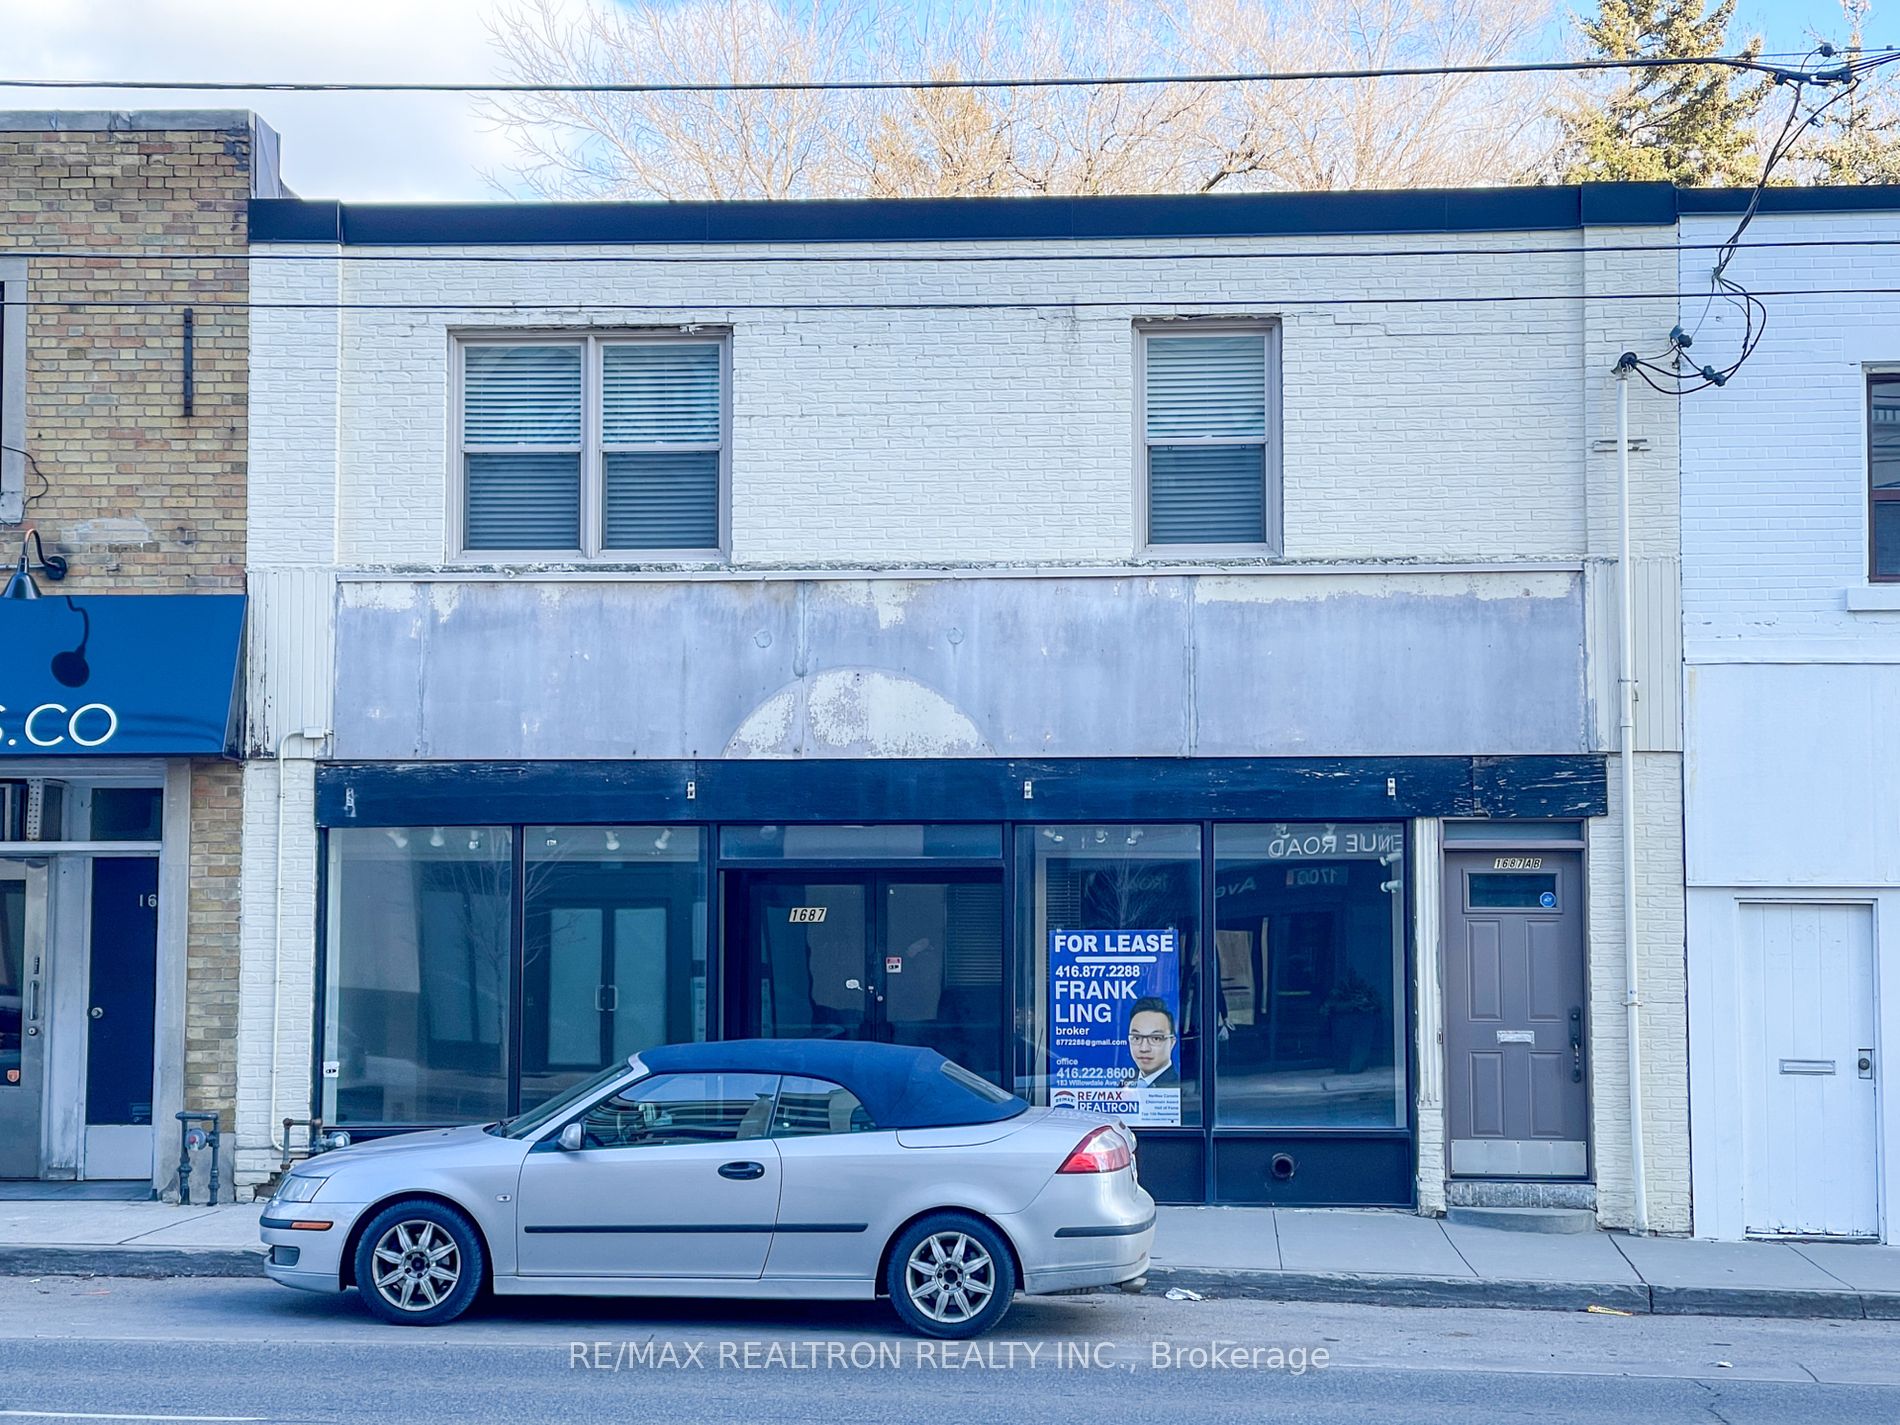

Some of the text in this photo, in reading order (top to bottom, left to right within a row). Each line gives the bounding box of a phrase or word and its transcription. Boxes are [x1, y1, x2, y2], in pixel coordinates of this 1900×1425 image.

[1494, 858, 1541, 869] 1687AB
[792, 908, 825, 921] 1687
[1055, 935, 1173, 952] FOR LEASE
[1056, 966, 1140, 978] 416.877.2288
[1056, 980, 1138, 999] FRANK
[1056, 1004, 1112, 1023] LING
[1056, 1026, 1090, 1036] broker
[1056, 1057, 1079, 1066] office
[1056, 1067, 1136, 1079] 416.222.8600
[1077, 1091, 1123, 1101] RE/MAX
[1079, 1102, 1138, 1114] REALTRON
